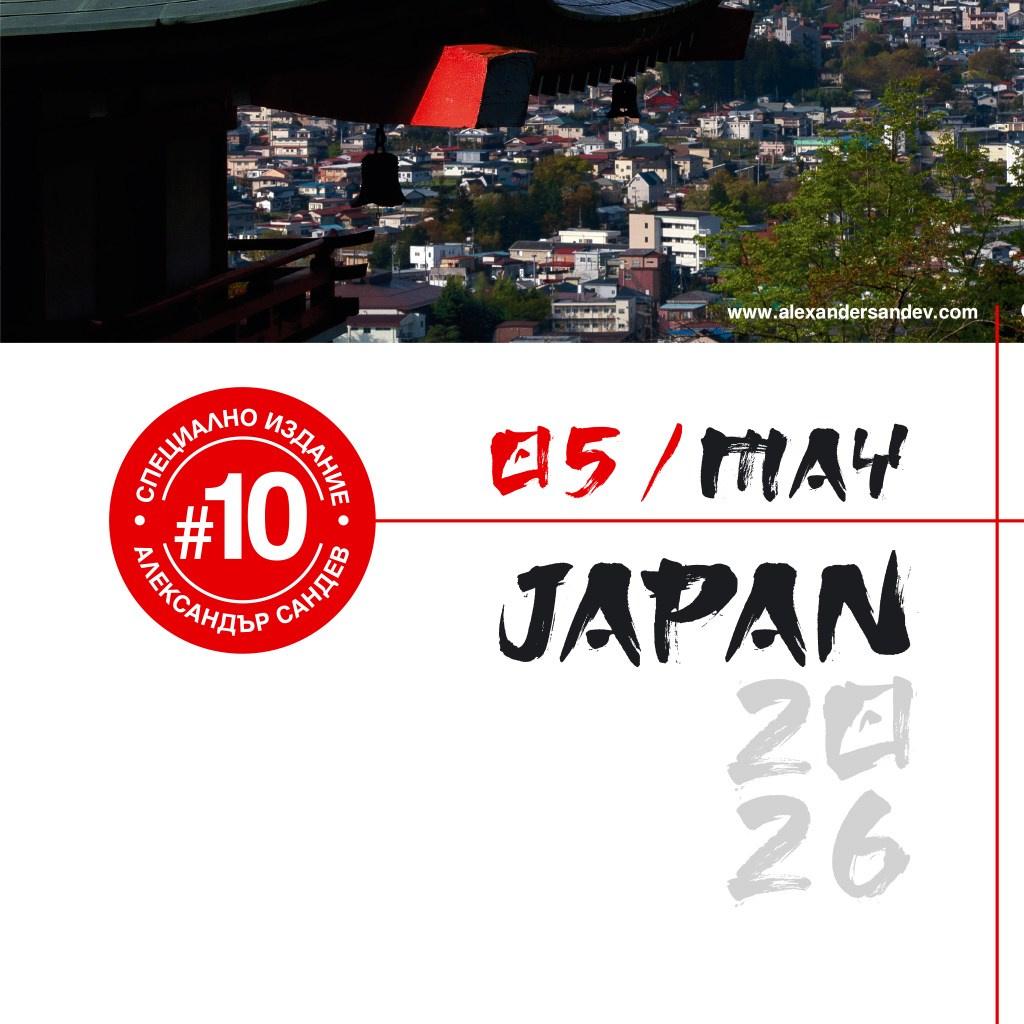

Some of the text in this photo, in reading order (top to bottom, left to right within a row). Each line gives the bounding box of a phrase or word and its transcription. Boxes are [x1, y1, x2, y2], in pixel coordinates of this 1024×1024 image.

[136, 408, 350, 506] СПЕЦИАЛНО ИЗДАНИЕ
[174, 471, 307, 561] #10
[134, 546, 350, 636] АЛЕКСАНДЪР САНДЕВ
[499, 550, 911, 668] JAPAN
